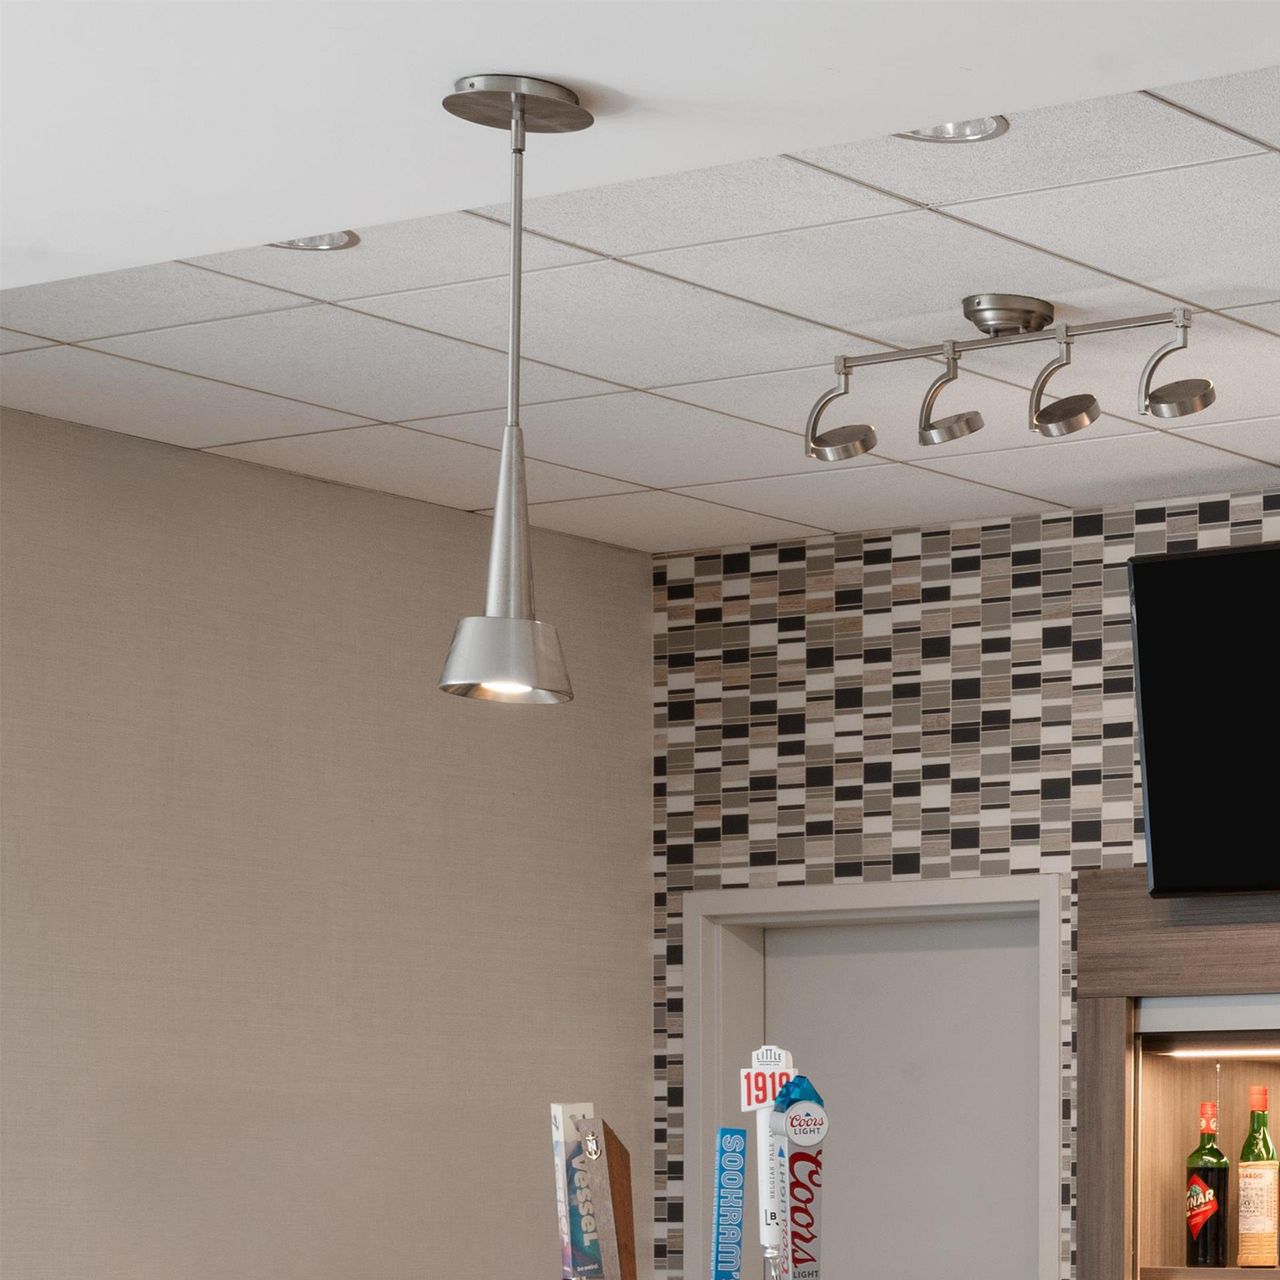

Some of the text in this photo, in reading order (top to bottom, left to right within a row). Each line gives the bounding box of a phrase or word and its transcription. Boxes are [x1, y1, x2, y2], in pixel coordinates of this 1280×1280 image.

[756, 1049, 782, 1060] LITTLE
[789, 1114, 825, 1128] Coors
[793, 1127, 821, 1135] LIGHT
[788, 1149, 823, 1269] Coors
[792, 1270, 820, 1279] LIGHT
